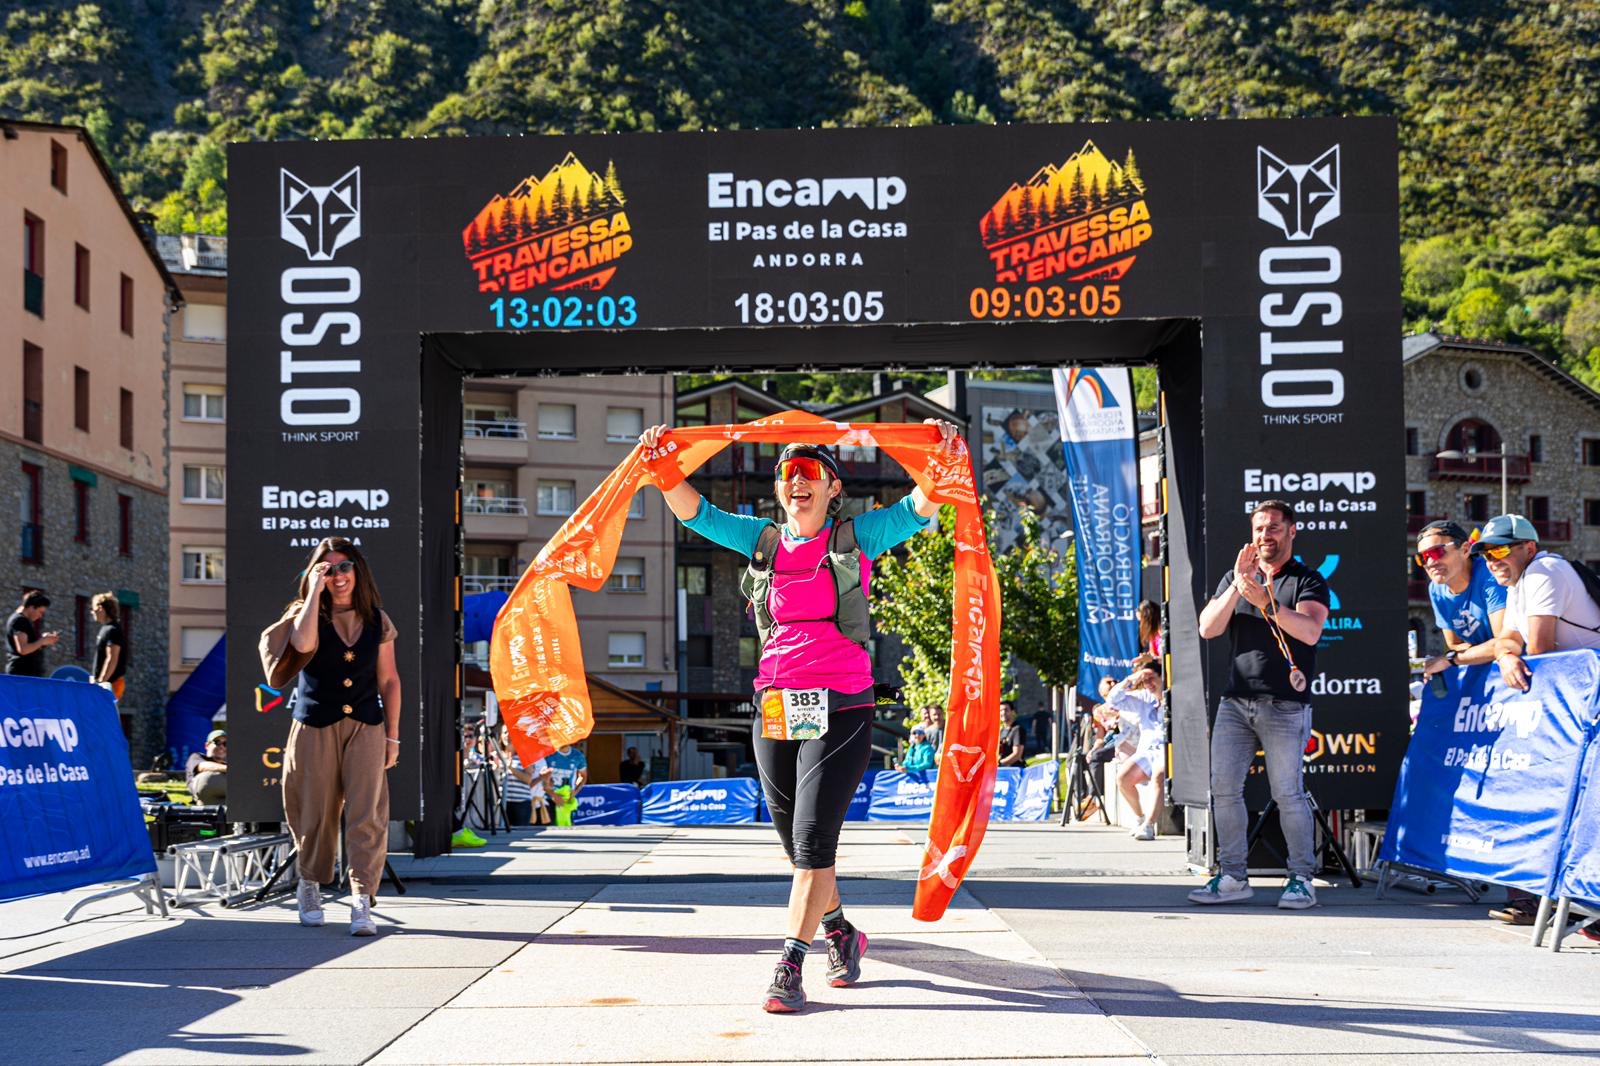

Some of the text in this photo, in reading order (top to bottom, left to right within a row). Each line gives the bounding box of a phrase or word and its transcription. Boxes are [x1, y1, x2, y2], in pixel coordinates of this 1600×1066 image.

[708, 172, 907, 210] Encamp
[708, 219, 907, 241] El Pas de la Casa
[989, 200, 1150, 271] TRAVESSA
[473, 211, 631, 281] TRAVESSA
[995, 223, 1152, 282] D'ENCAMP
[479, 234, 633, 292] D'ENCAMP
[753, 252, 863, 267] ANDORRA
[490, 296, 638, 328] 13:02:03
[735, 291, 884, 323] 18:03:05
[969, 285, 1121, 318] 09:03:05
[1259, 246, 1344, 408] OTSO
[280, 266, 361, 425] OTSO
[1263, 413, 1344, 424] THINK SPORT
[282, 431, 360, 442] THINK SPORT
[1244, 469, 1376, 494] Encamp
[262, 486, 389, 510] Encamp
[1294, 500, 1315, 513] de
[1319, 499, 1334, 512] la
[1337, 499, 1377, 512] Casa
[262, 516, 389, 530] El Pas de la Casa
[1296, 521, 1348, 530] DORRA
[290, 537, 361, 547] ANDA
[1322, 617, 1362, 629] ALIRA
[1310, 672, 1382, 695] dorra
[790, 692, 820, 706] 383
[0, 717, 79, 752] camp
[1303, 729, 1376, 763] OWN
[26, 764, 44, 785] de
[44, 762, 58, 782] la
[59, 762, 90, 782] Casa
[24, 845, 91, 869] www.encamp.ad
